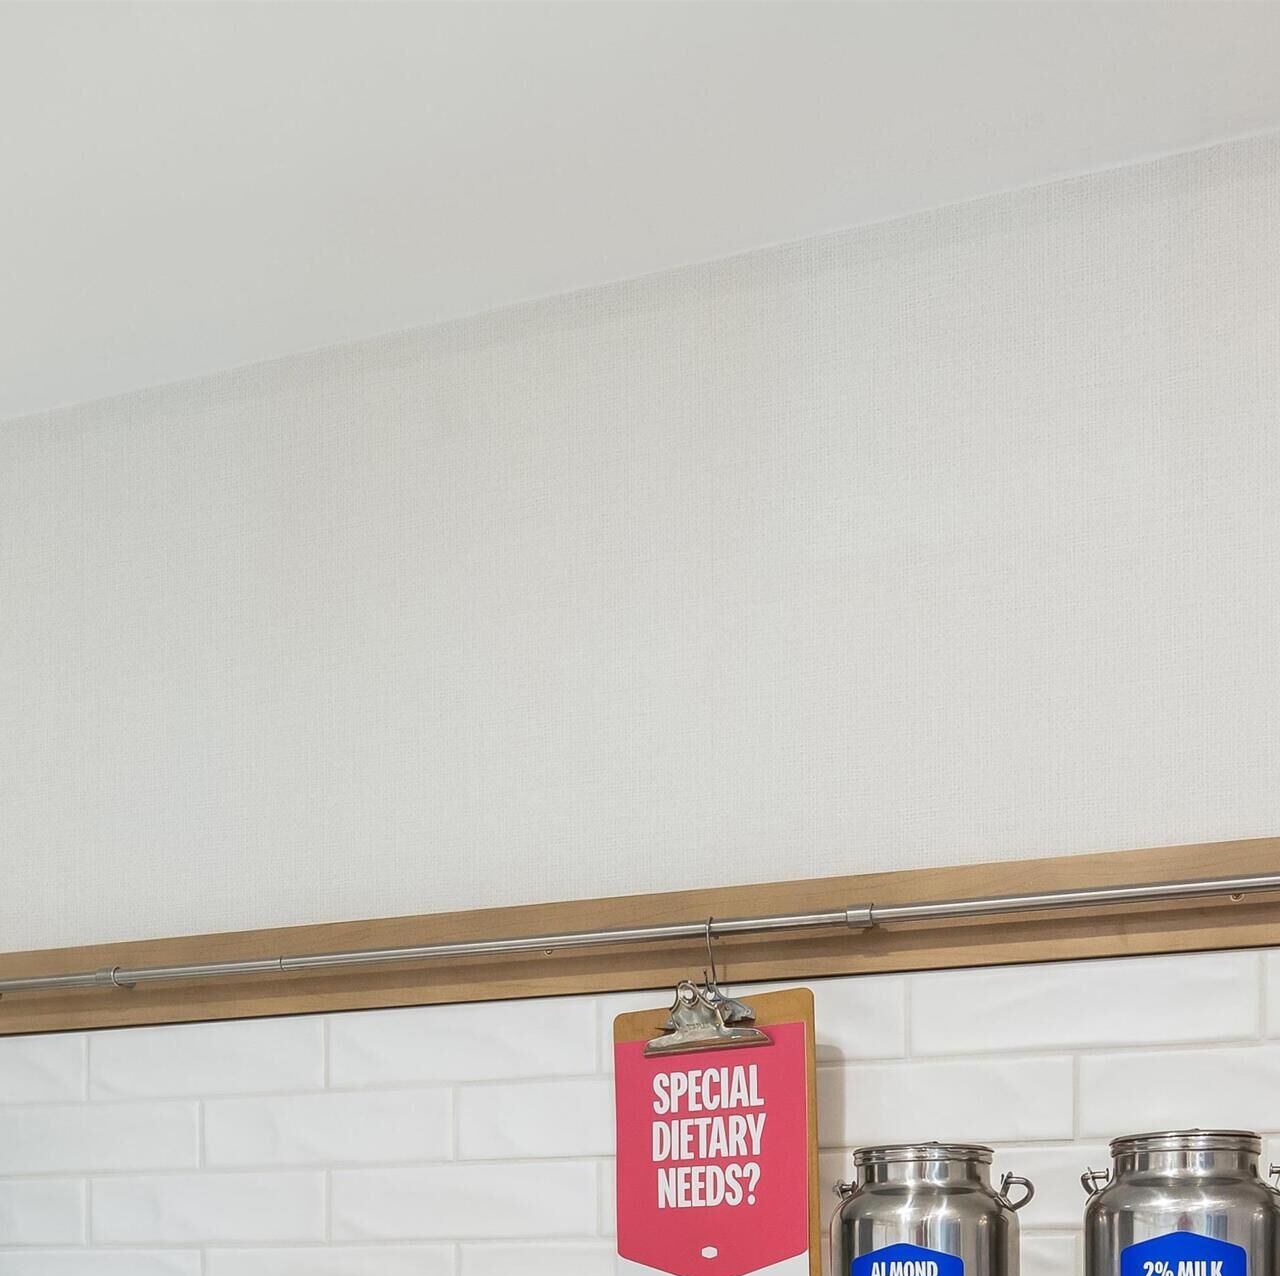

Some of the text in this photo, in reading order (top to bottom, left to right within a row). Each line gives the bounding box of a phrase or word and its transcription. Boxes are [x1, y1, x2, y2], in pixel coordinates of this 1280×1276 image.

[652, 1064, 765, 1115] SPECIAL
[652, 1113, 767, 1162] DIETARY
[657, 1161, 761, 1209] NEEDS?
